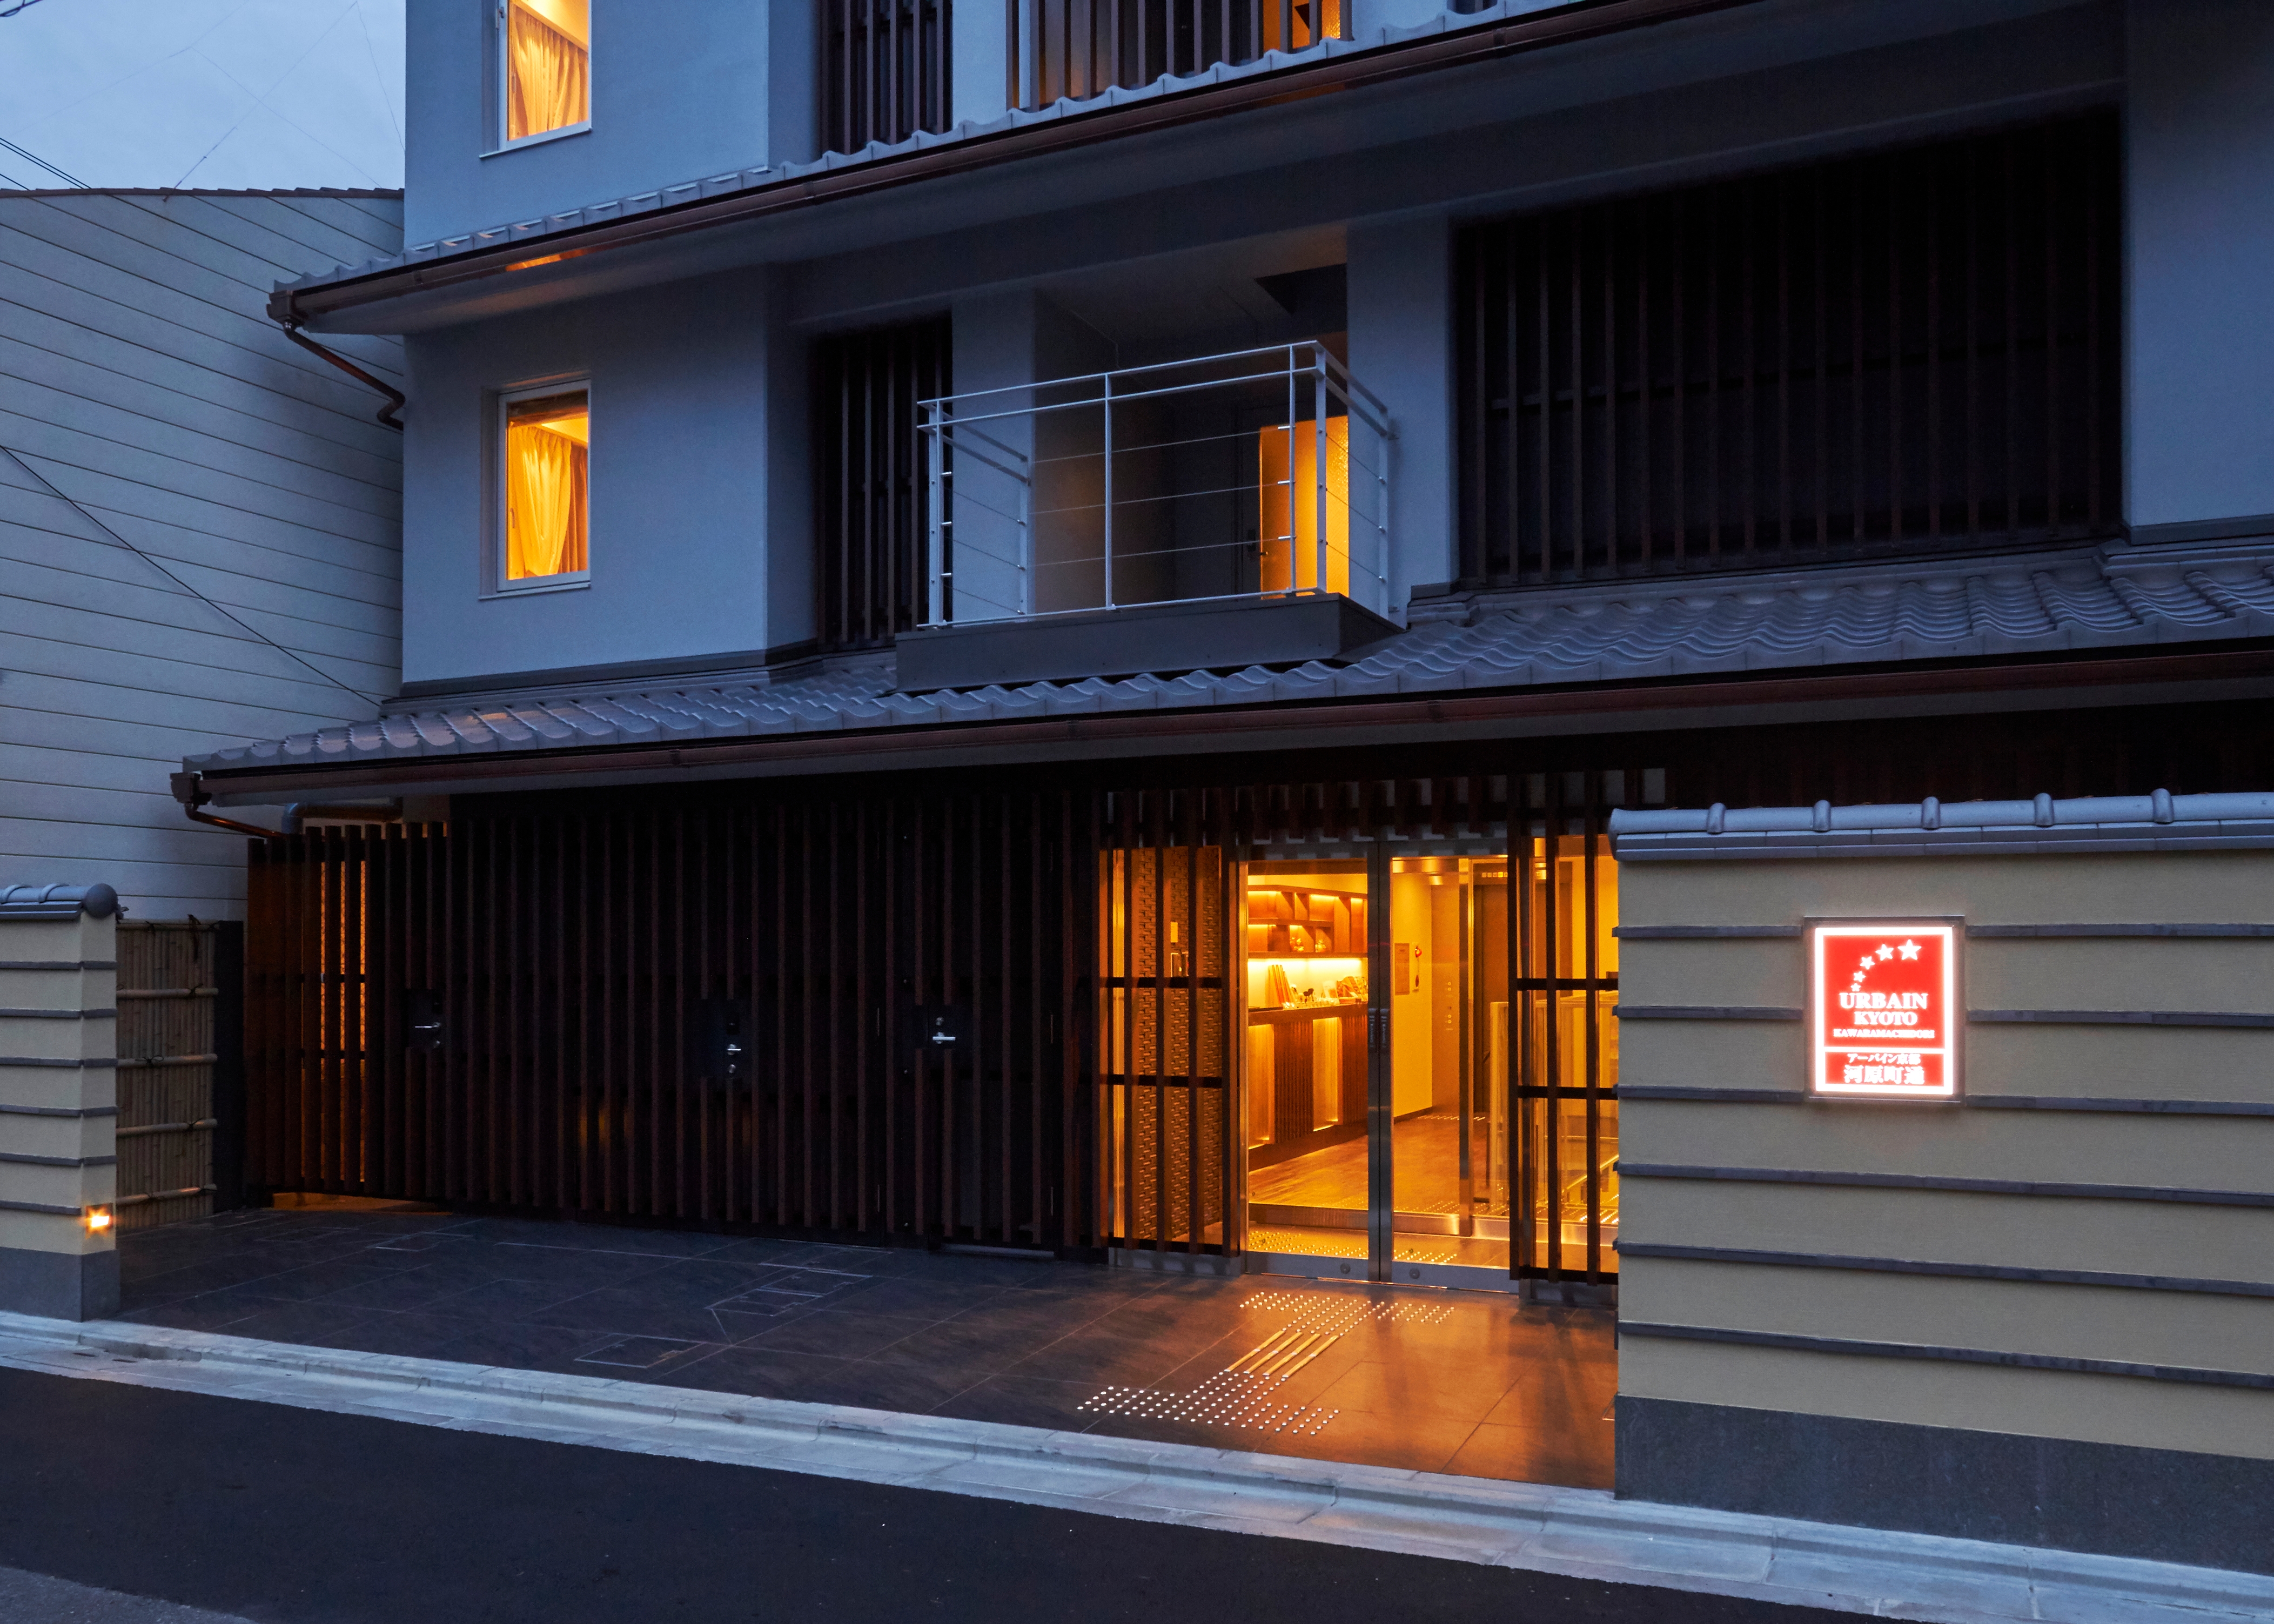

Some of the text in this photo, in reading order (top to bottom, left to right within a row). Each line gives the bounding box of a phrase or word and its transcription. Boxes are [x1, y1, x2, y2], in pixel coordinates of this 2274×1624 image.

[1839, 992, 1928, 1009] URBAIN
[1854, 1011, 1918, 1025] KYOTO
[1843, 1065, 1925, 1085] 河原町通
